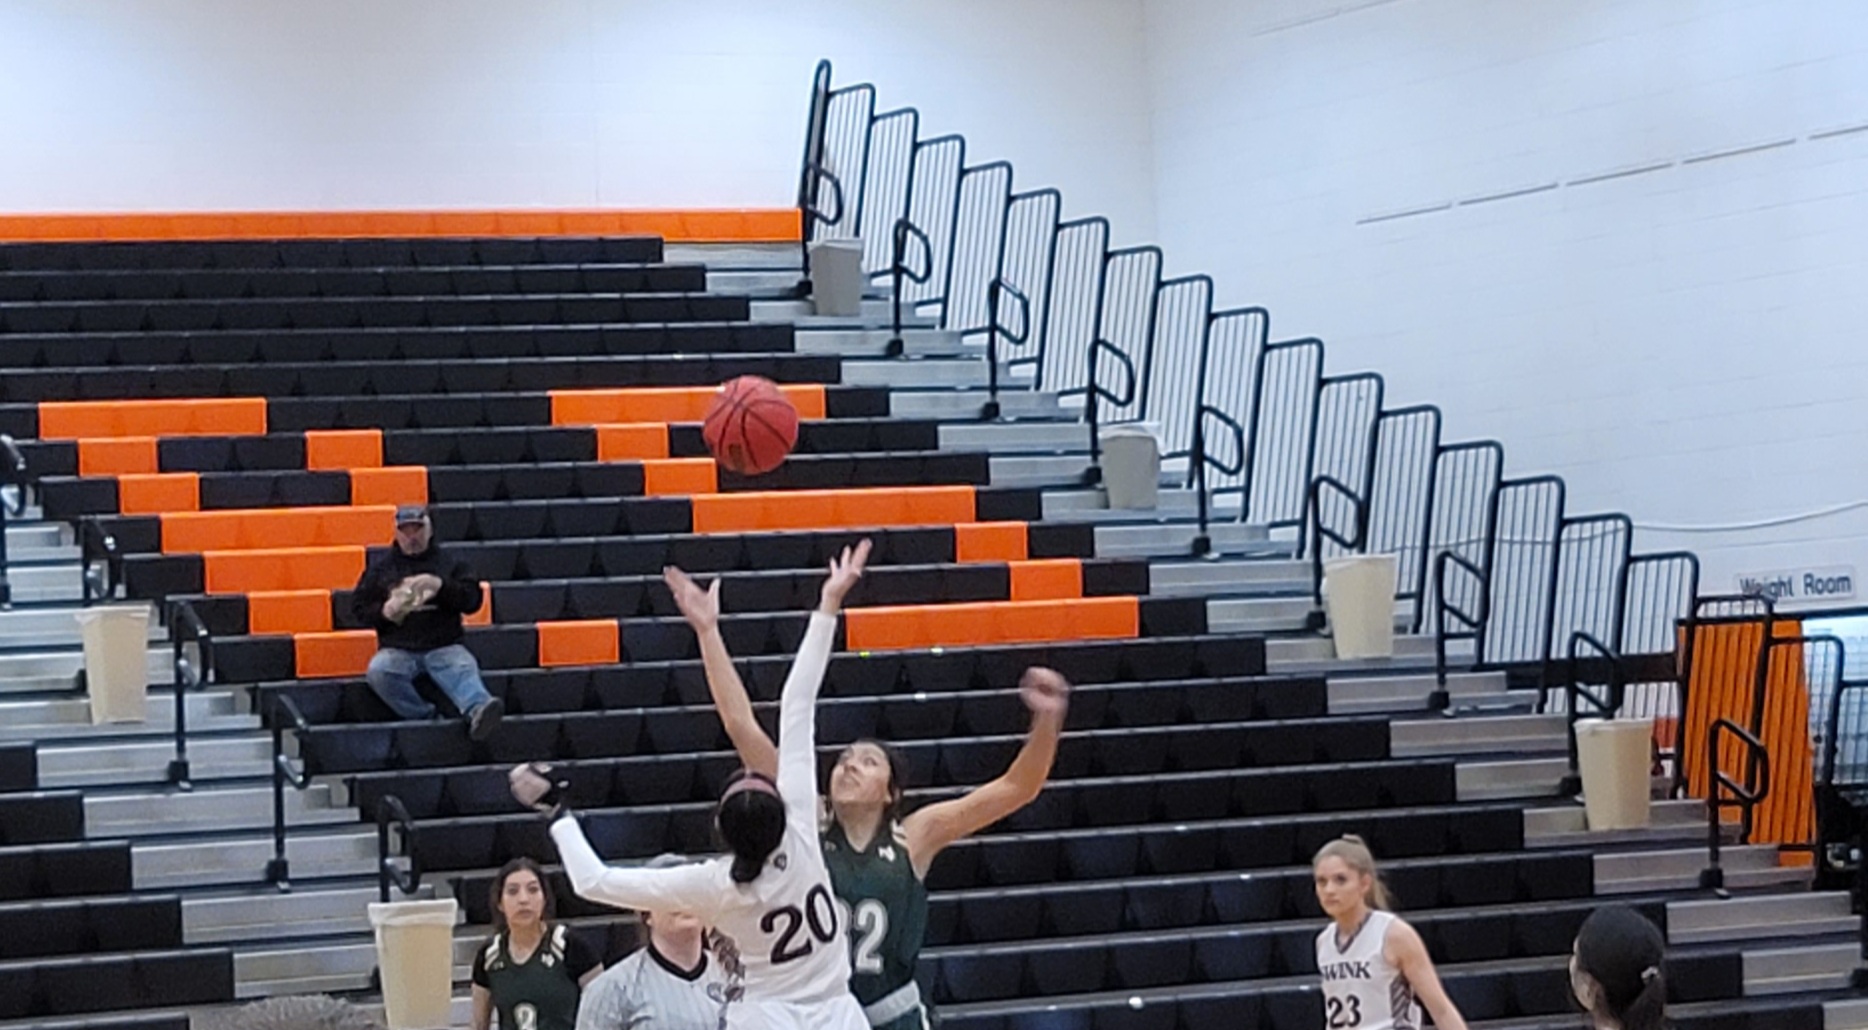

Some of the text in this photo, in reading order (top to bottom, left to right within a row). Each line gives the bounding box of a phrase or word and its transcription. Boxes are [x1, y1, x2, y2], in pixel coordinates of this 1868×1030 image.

[1803, 572, 1852, 595] Room
[761, 883, 837, 965] 20
[1327, 994, 1361, 1030] 23
